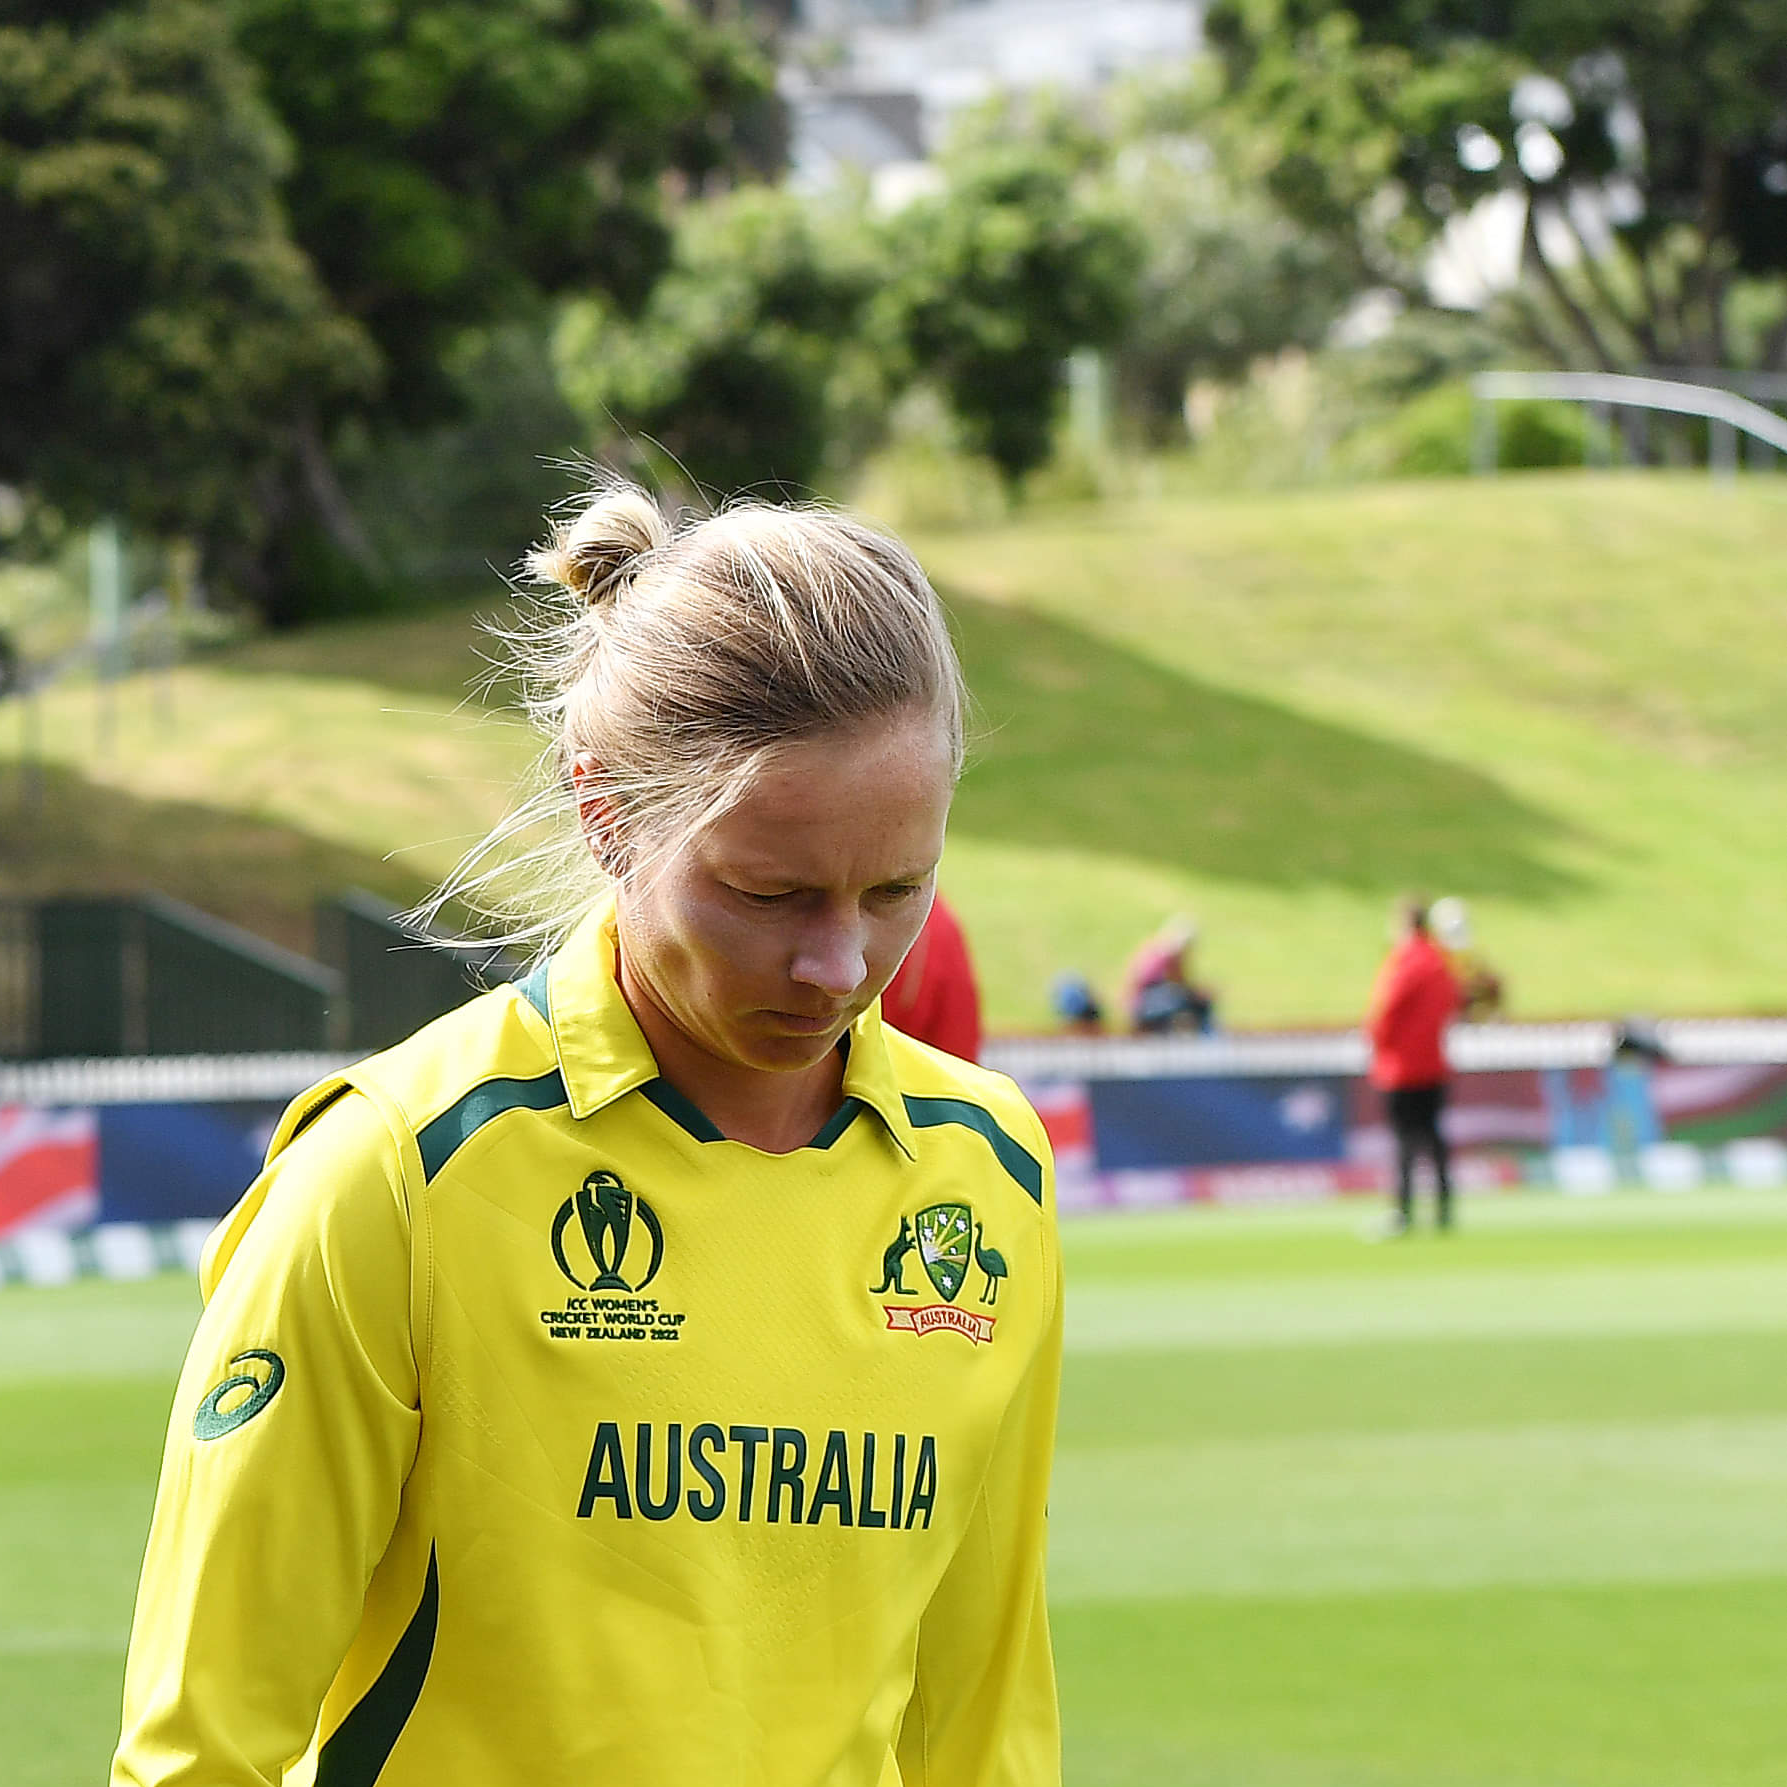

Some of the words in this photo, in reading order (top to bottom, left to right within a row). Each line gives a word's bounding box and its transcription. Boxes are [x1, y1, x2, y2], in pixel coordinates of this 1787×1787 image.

[567, 1297, 588, 1310] ICC
[591, 1299, 659, 1311] WOMEN'S
[541, 1311, 599, 1324] CRICKET
[603, 1313, 655, 1325] WORLD
[658, 1314, 686, 1326] CUP
[920, 1310, 977, 1333] AUSTRALIA
[550, 1327, 581, 1339] NEW
[586, 1327, 646, 1340] ZEALAND
[576, 1421, 937, 1530] AUSTRALIA
